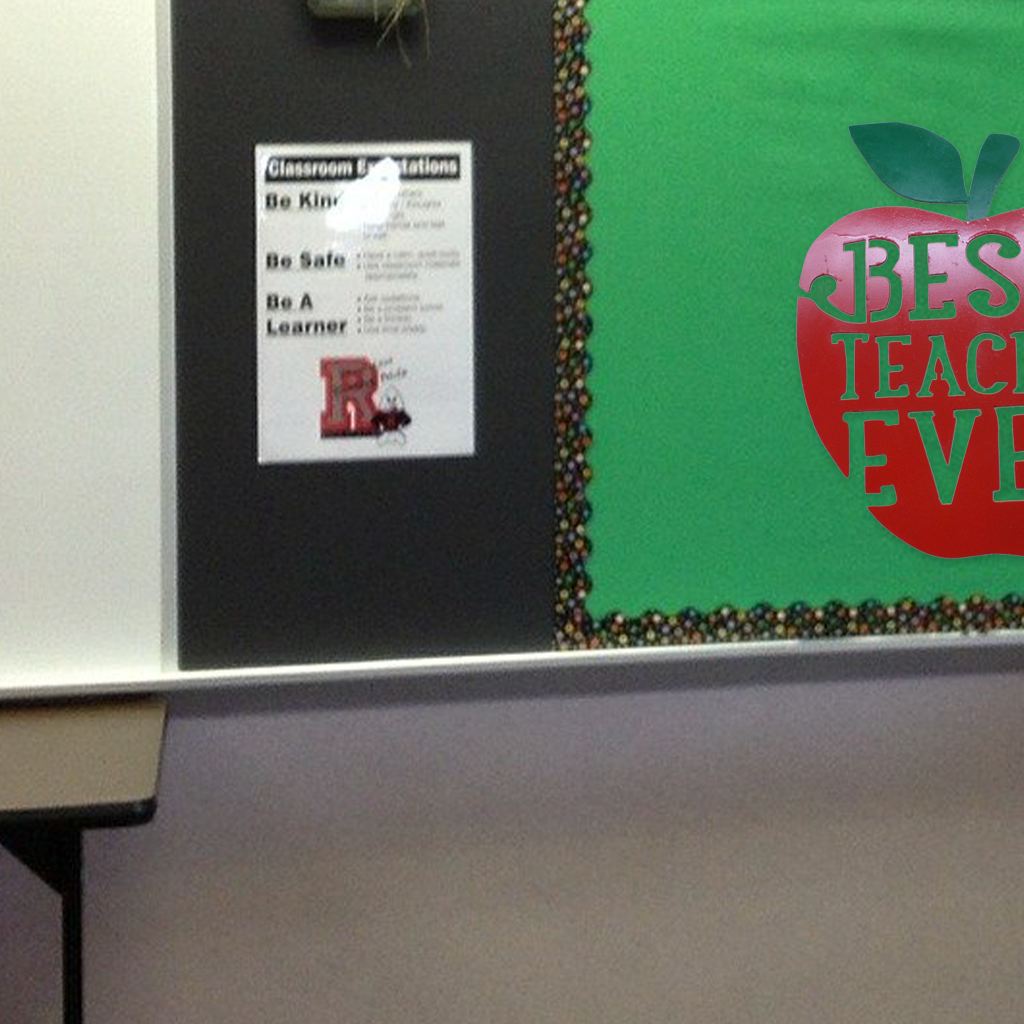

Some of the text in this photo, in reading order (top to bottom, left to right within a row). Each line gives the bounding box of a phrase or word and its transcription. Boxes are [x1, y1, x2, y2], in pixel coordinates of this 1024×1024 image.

[267, 158, 352, 176] Classroom
[265, 192, 341, 210] Be Kin
[266, 252, 292, 269] Be
[299, 250, 346, 269] Safe
[266, 293, 313, 311] Be A
[266, 319, 348, 337] Learner
